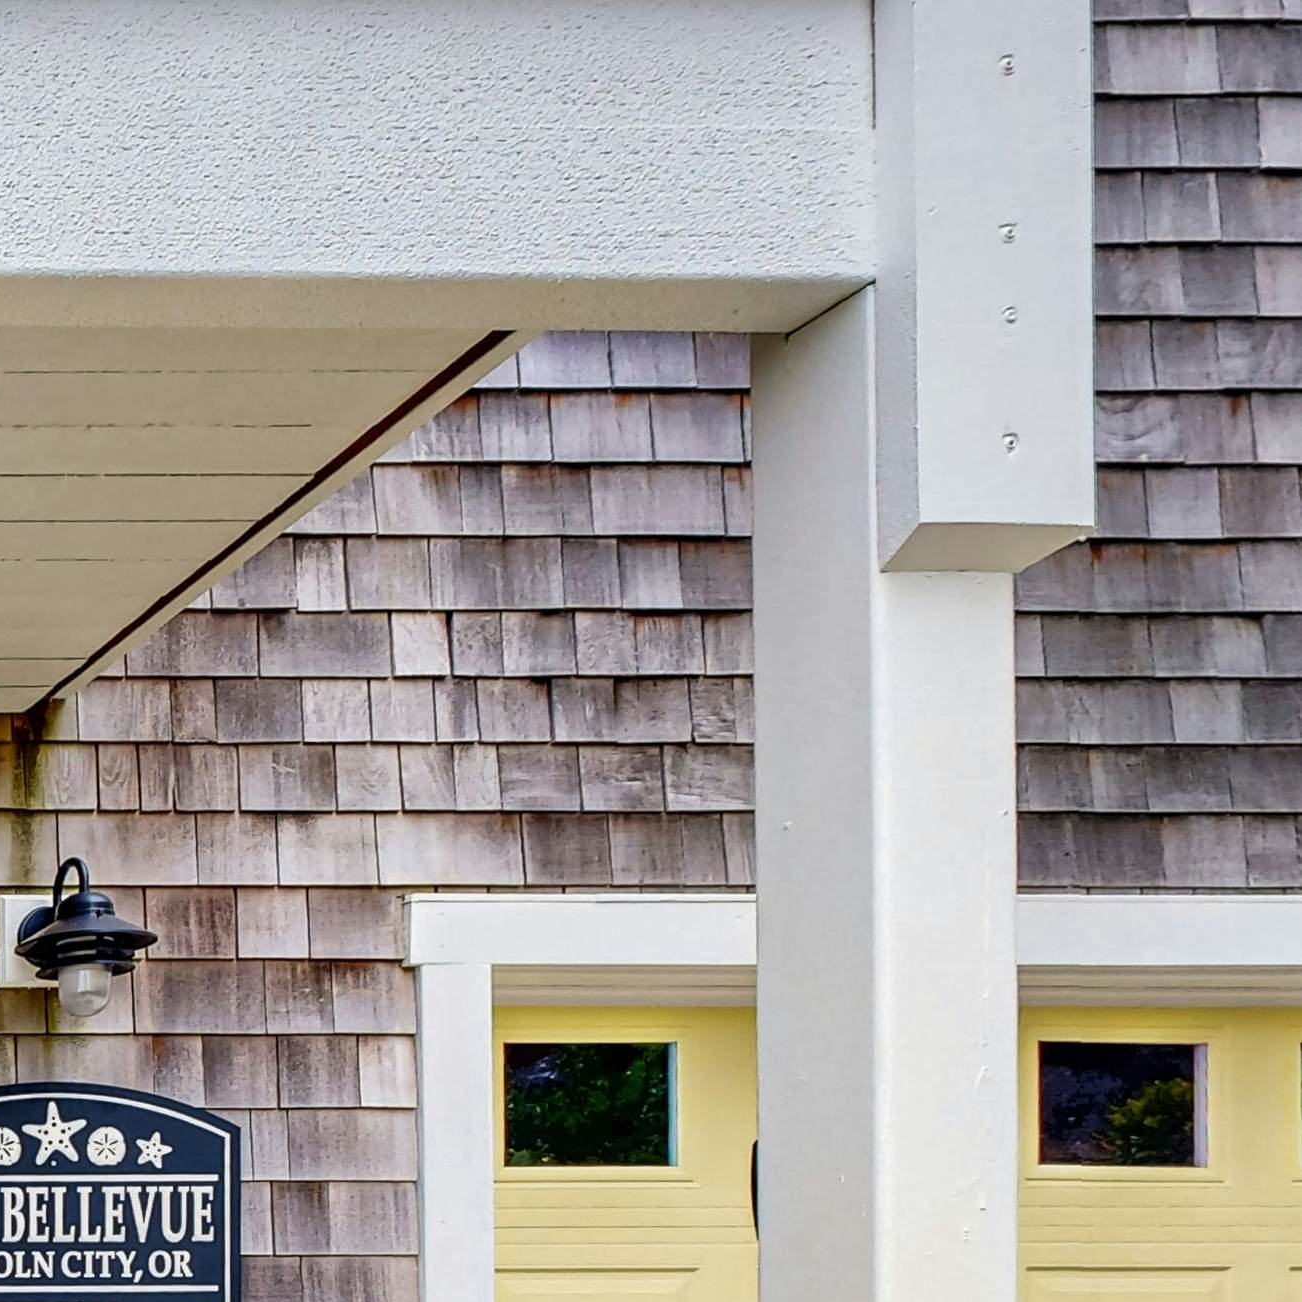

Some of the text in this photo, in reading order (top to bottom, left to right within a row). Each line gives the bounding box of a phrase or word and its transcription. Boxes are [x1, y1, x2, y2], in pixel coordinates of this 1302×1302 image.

[0, 1186, 215, 1243] BELLEVUE
[60, 1250, 144, 1284] CITY,
[148, 1250, 193, 1279] OR
